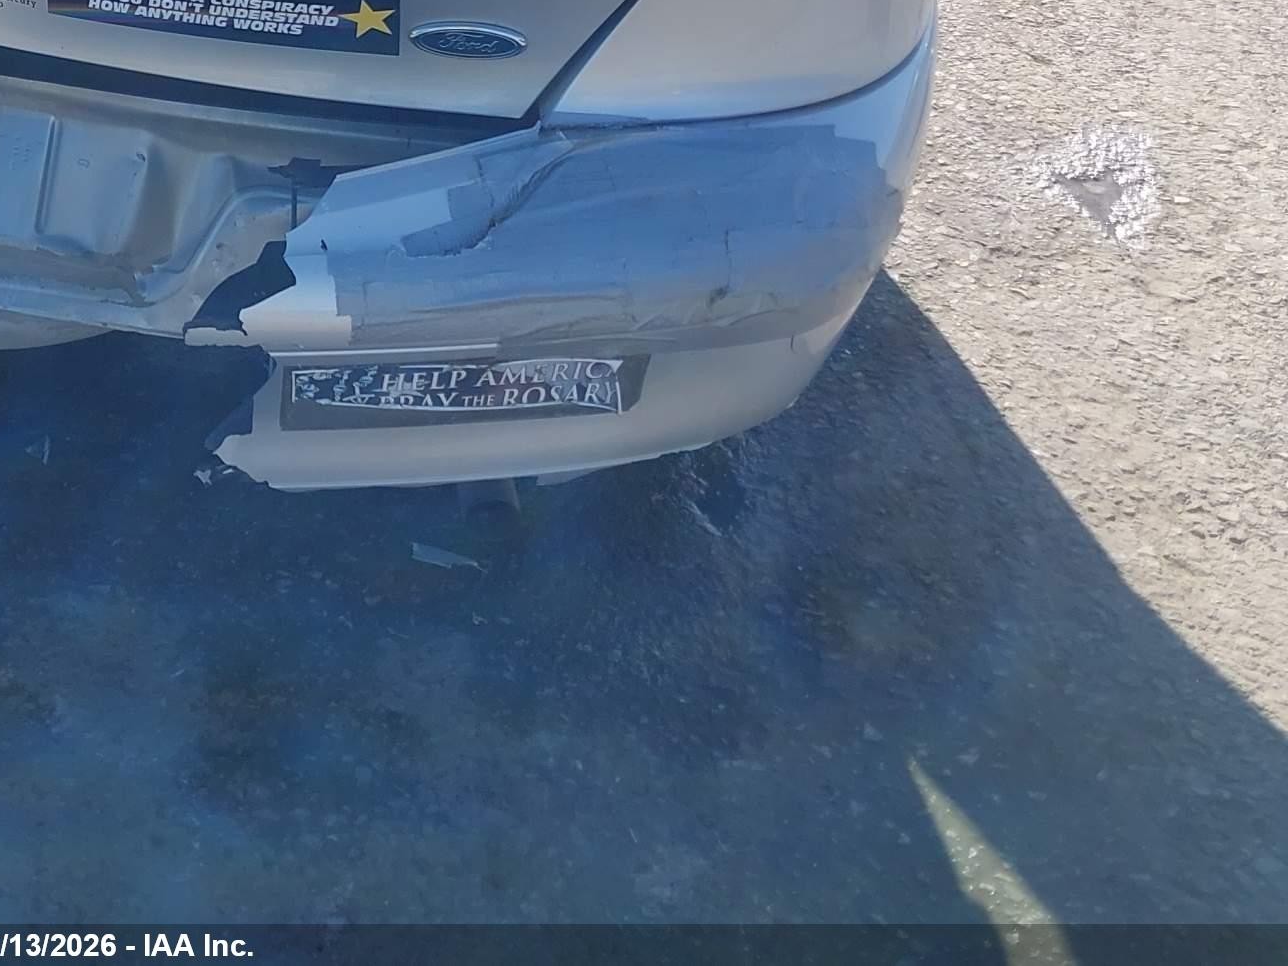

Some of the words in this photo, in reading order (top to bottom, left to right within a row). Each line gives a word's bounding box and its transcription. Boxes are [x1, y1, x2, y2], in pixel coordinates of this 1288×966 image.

[134, 6, 228, 27] ANYTHING
[233, 18, 304, 35] WORKS
[208, 5, 340, 27] UNDERSTAND
[438, 32, 500, 53] Ford
[379, 369, 467, 392] HELP
[473, 361, 613, 387] AMERIC
[461, 394, 495, 407] THE
[502, 381, 617, 407] ROSARY
